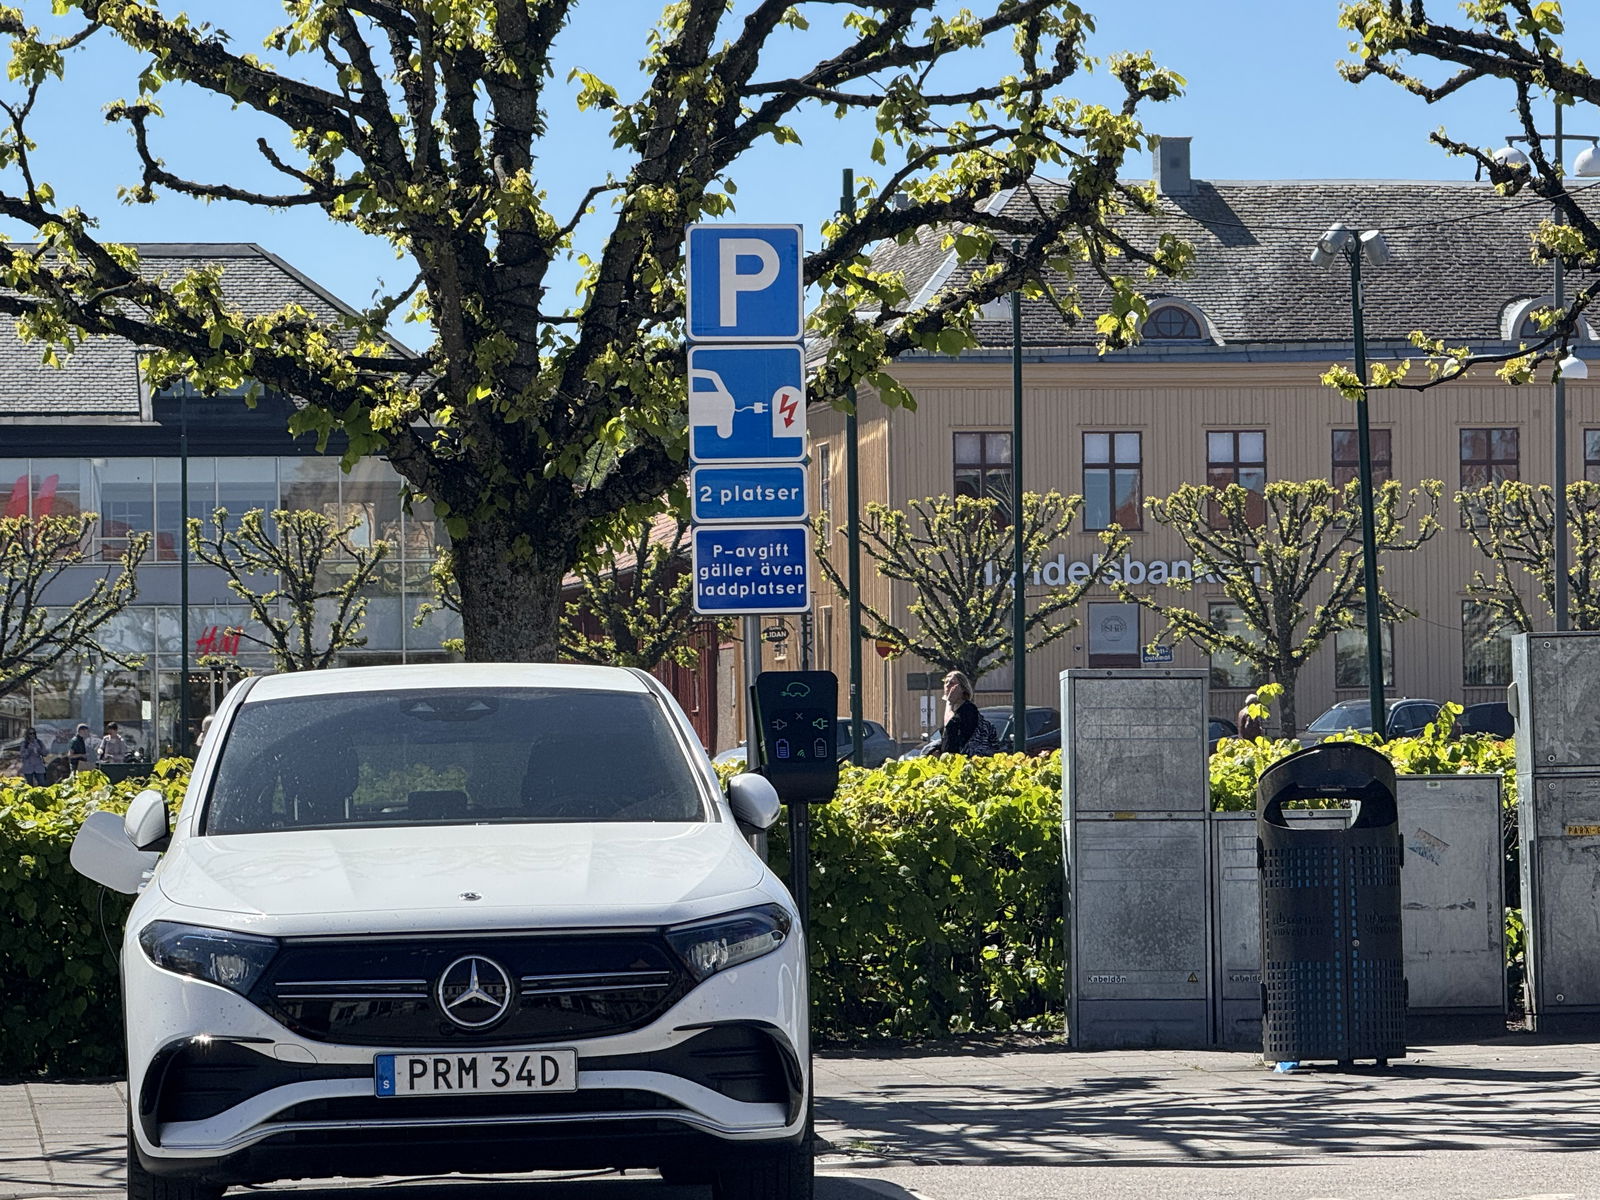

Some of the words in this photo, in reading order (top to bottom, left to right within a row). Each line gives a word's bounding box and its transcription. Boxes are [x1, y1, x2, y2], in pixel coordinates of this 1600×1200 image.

[719, 238, 780, 327] P
[700, 485, 712, 502] 2
[720, 485, 800, 505] platser
[713, 543, 789, 560] P-avgift
[699, 563, 753, 580] gäller
[760, 562, 803, 576] även
[699, 581, 805, 598] laddplatser
[1229, 974, 1262, 983] Kabeld
[409, 1057, 478, 1090] PRM
[491, 1055, 560, 1087] 34D
[383, 1080, 390, 1089] S
